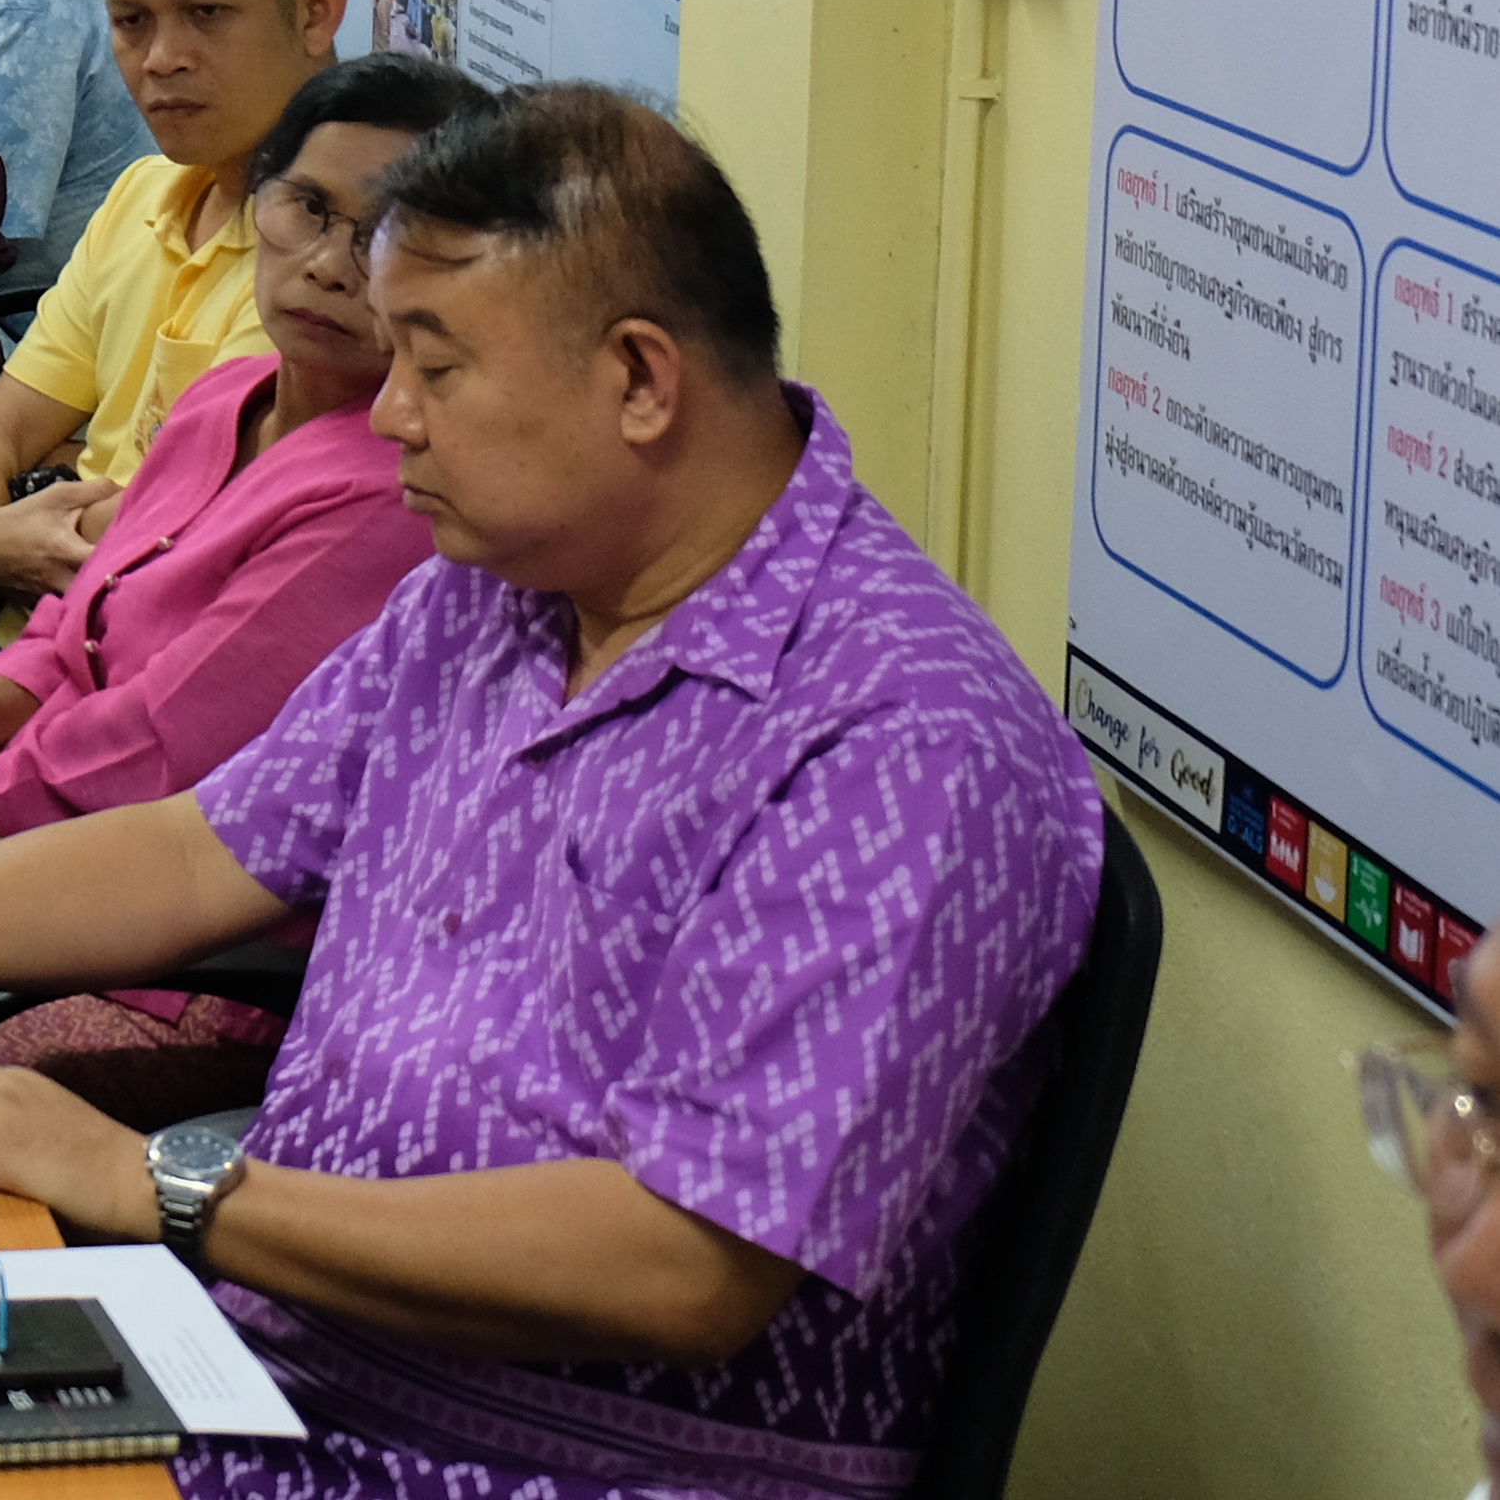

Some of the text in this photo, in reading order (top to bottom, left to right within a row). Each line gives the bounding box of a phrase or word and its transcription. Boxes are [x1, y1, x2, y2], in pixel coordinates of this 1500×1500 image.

[1117, 167, 1158, 210] กลยุทธ์
[1163, 183, 1169, 212] 1
[1308, 316, 1343, 364] สู่การ
[1108, 366, 1147, 411] กลยุทธ์
[1153, 386, 1160, 415] 2
[1438, 446, 1448, 479] 2
[1430, 597, 1440, 631] 3
[1075, 678, 1130, 748] Change
[1138, 726, 1161, 769] for
[1171, 749, 1214, 806] Good
